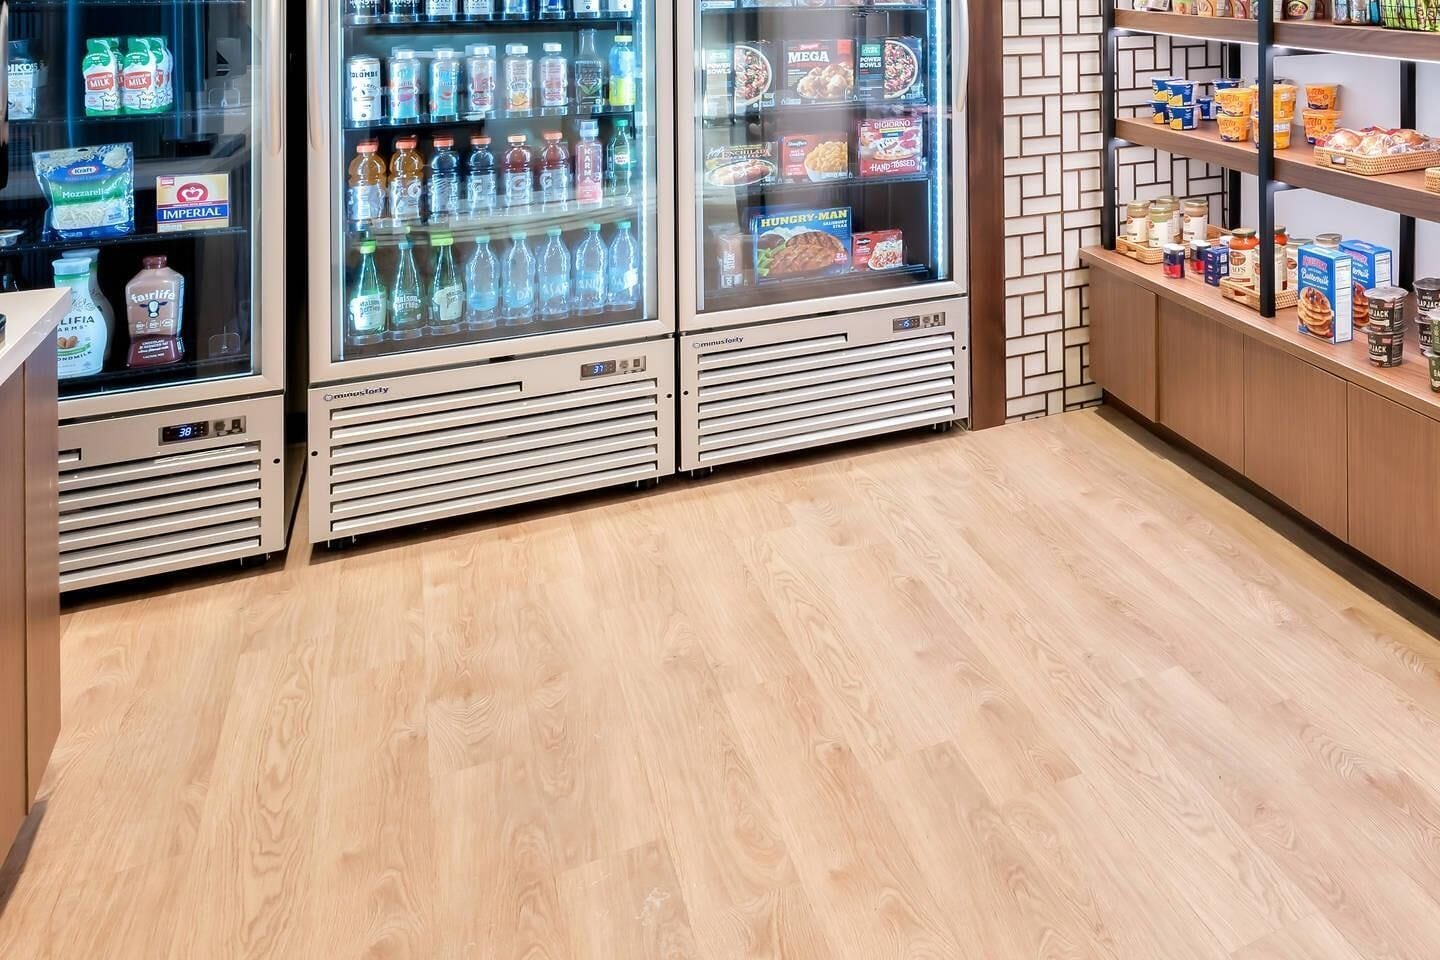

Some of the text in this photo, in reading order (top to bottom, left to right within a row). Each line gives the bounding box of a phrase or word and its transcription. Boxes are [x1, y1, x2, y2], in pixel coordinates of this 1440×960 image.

[788, 50, 830, 65] MEGA
[90, 79, 110, 88] MILK
[128, 78, 148, 87] MILK
[583, 147, 592, 186] KARMA
[163, 207, 222, 220] IMPERIAL
[131, 289, 177, 303] fairlife
[699, 336, 745, 349] minusforty
[592, 364, 604, 375] 37
[333, 385, 390, 401] minusforty
[178, 426, 192, 438] 38
